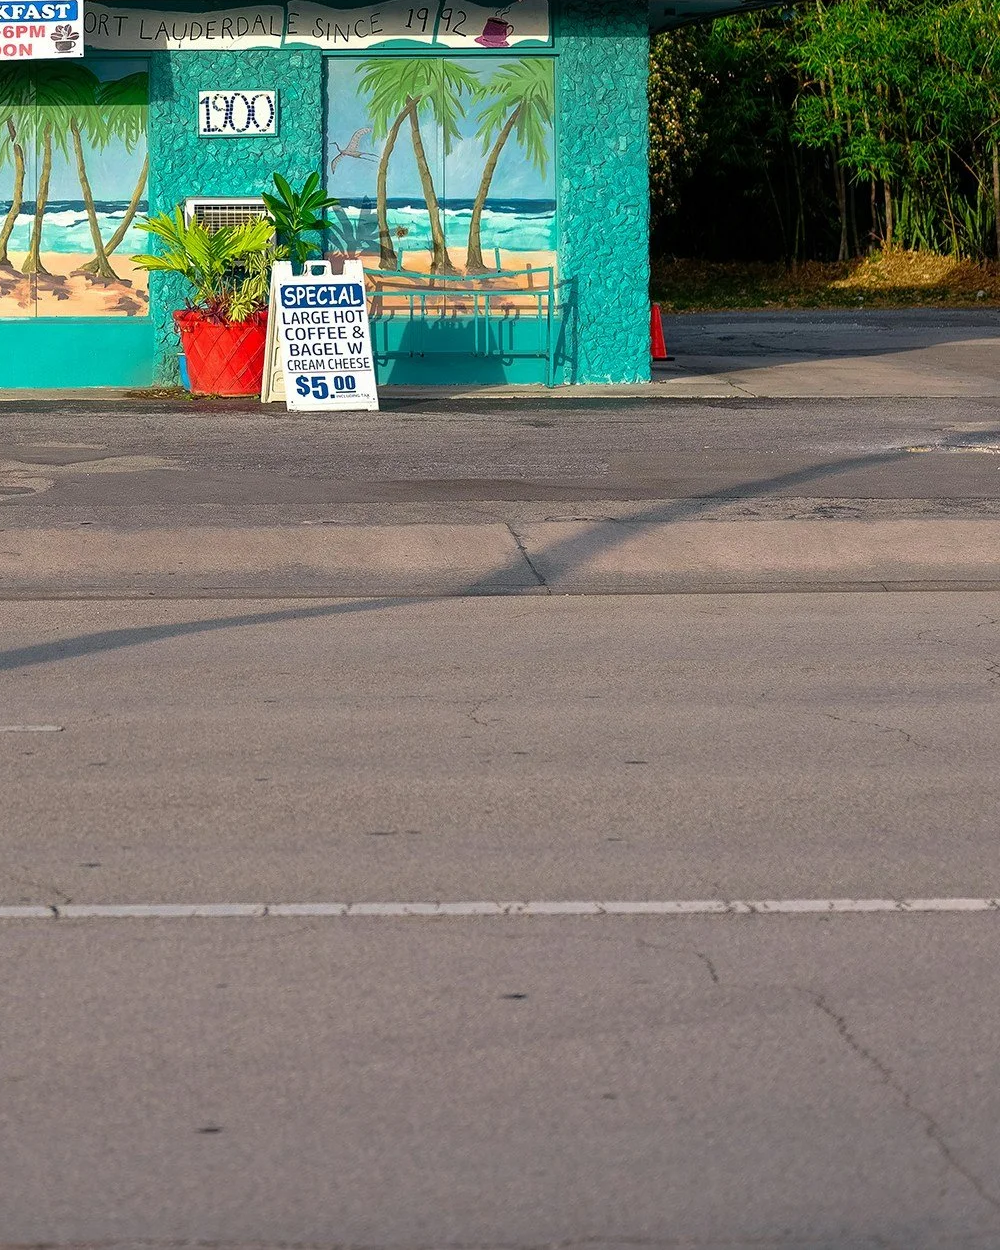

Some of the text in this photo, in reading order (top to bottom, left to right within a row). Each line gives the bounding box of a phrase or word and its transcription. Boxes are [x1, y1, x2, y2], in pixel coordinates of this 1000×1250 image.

[83, 7, 467, 44] ORT LAUDERDALE SINCE 1992
[200, 92, 275, 133] 1900
[284, 285, 361, 306] SPECIAL
[282, 309, 365, 325] LARGE HOT
[285, 325, 365, 341] COFFEE &
[289, 341, 363, 357] BAGEL W
[287, 357, 371, 371] CREAM CHEESE
[295, 374, 357, 400] $5.00
